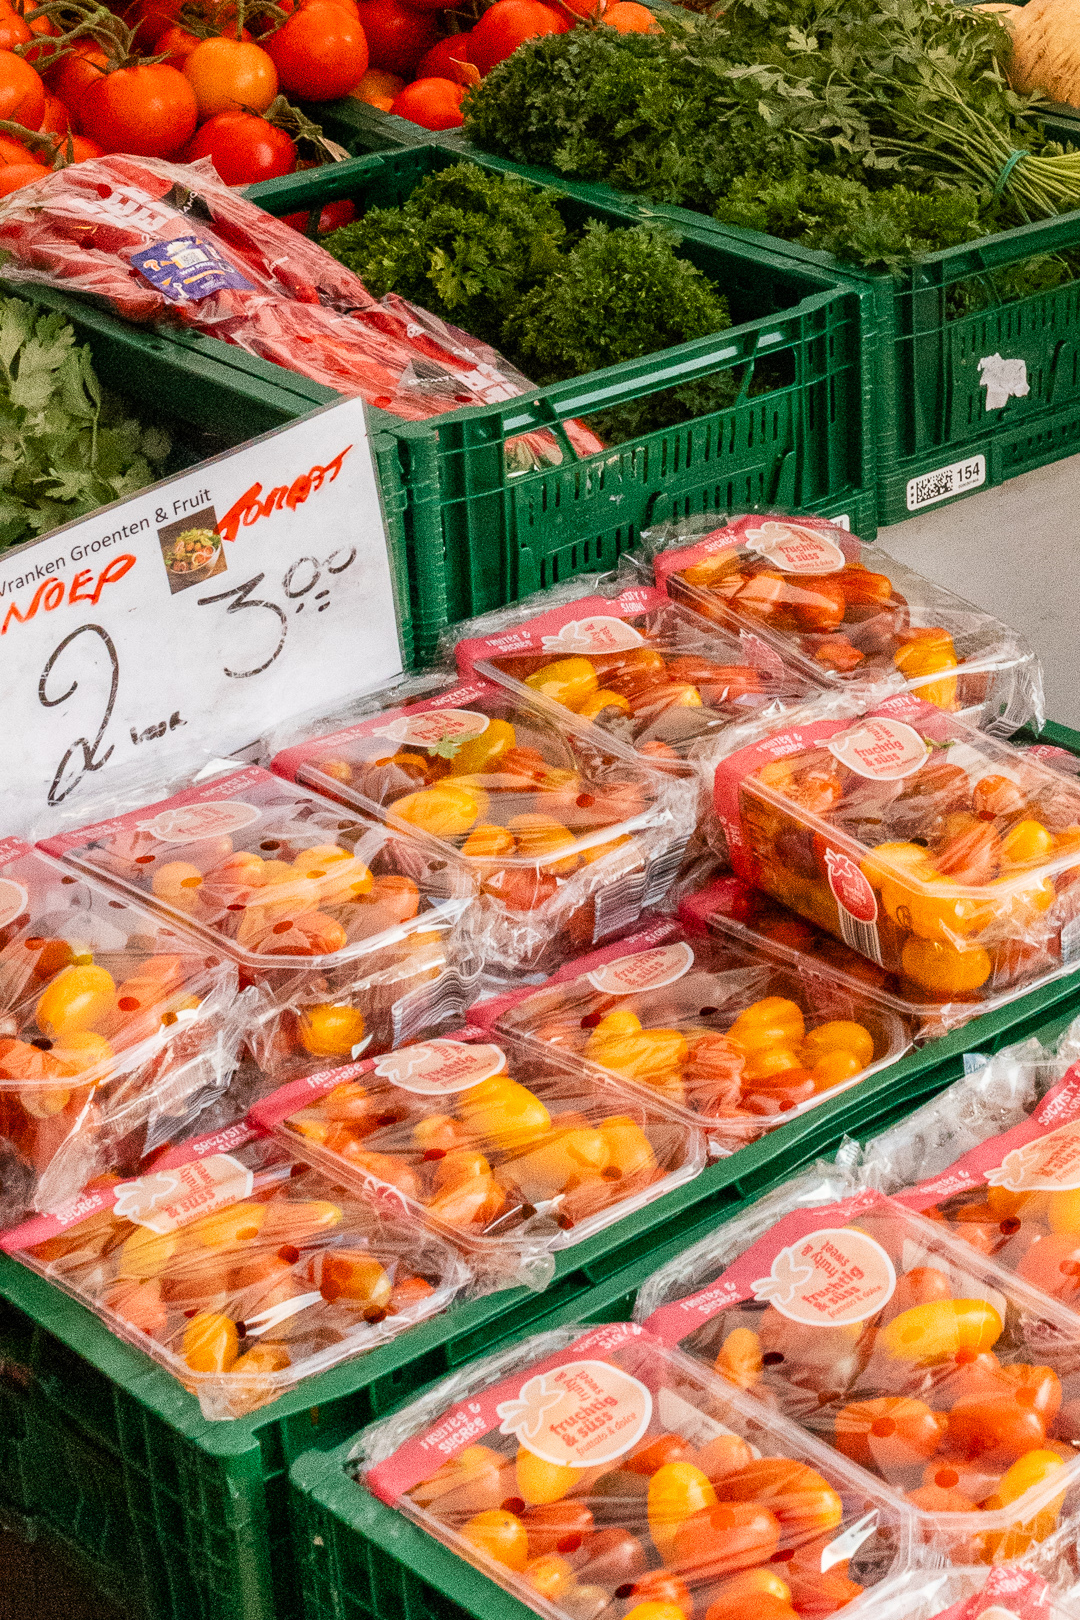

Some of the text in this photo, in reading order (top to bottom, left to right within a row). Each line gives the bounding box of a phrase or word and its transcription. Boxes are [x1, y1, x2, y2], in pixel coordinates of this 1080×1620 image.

[957, 461, 980, 482] 154
[69, 514, 151, 563] Groenten
[155, 506, 169, 524] &
[172, 487, 212, 518] Fruit
[0, 552, 137, 636] NOEP
[37, 623, 120, 807] 2
[853, 739, 904, 764] fruchtig
[875, 750, 901, 767] süss
[801, 1264, 866, 1303] fruchtig
[549, 1394, 619, 1437] fruchtig
[578, 1411, 616, 1442] süss
